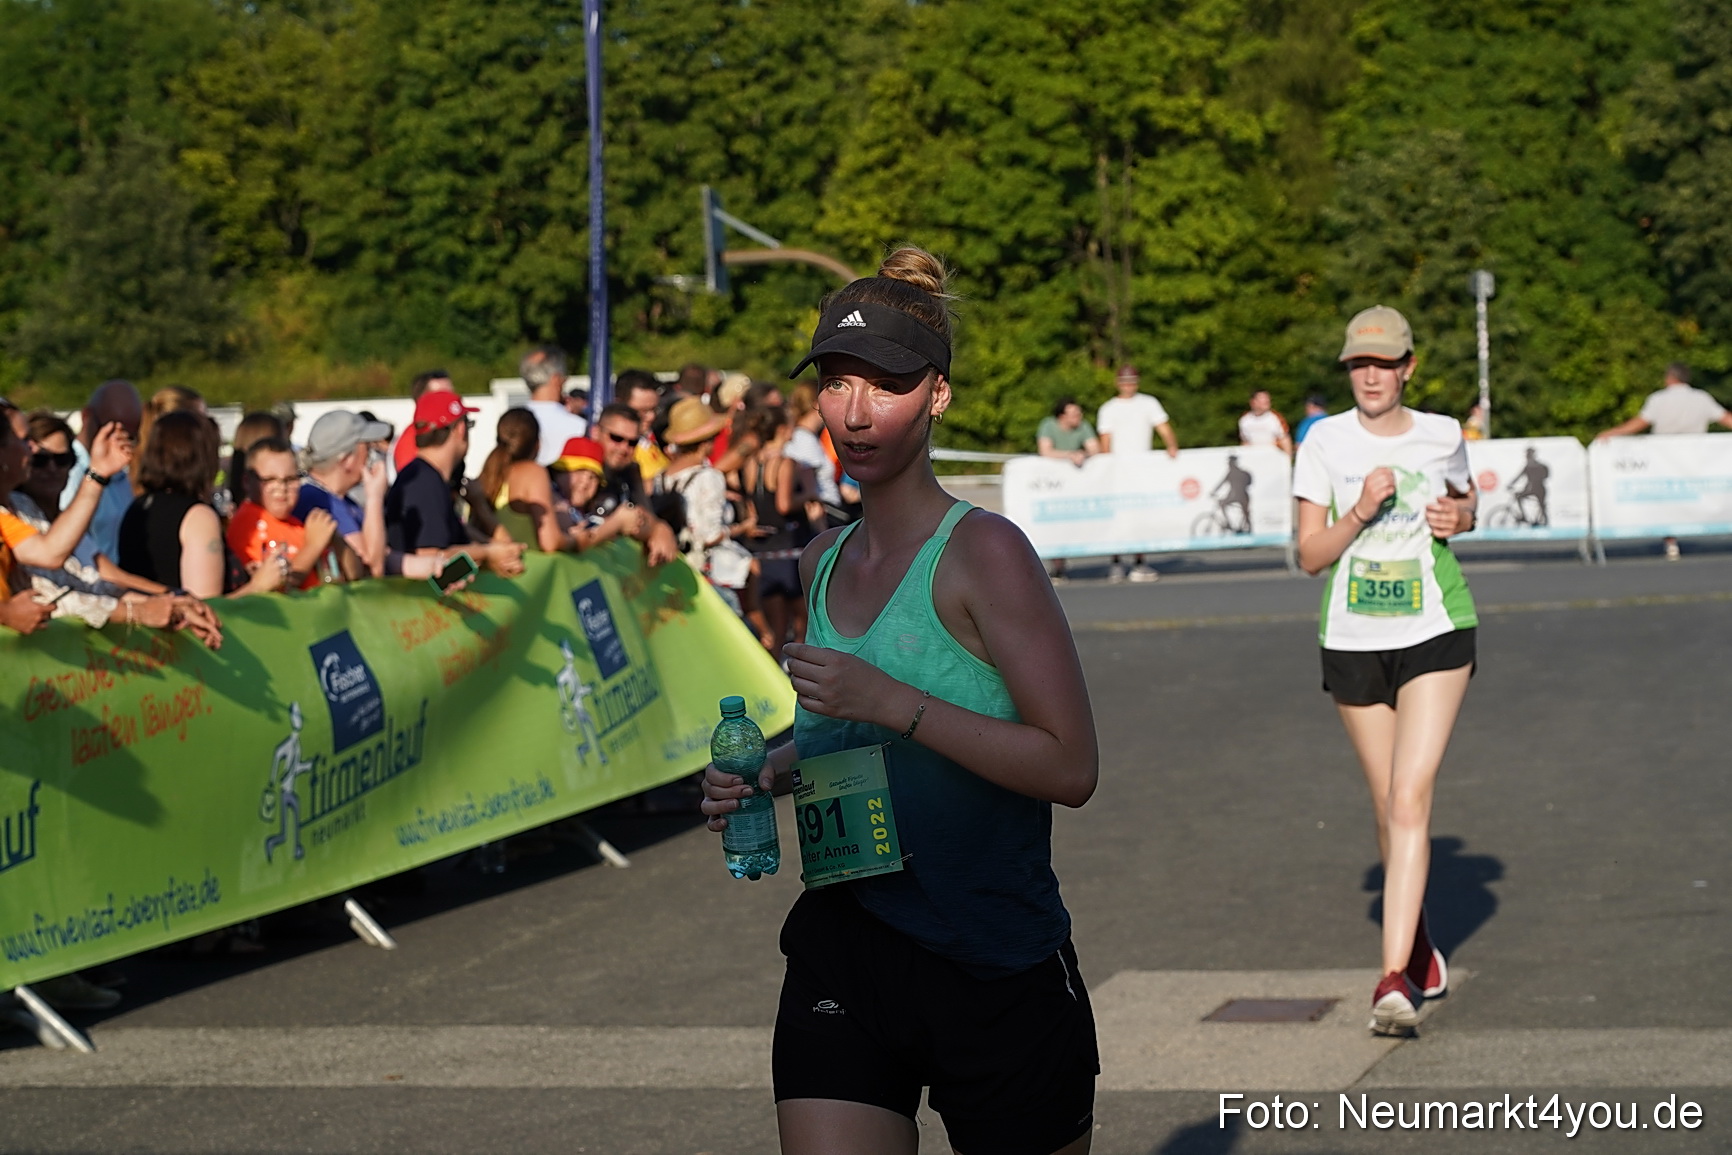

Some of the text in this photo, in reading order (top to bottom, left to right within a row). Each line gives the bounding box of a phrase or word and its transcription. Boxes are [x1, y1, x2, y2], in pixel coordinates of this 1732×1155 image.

[1365, 579, 1406, 599] 356
[309, 698, 428, 822] firmenlauf
[0, 779, 41, 868] uf
[824, 844, 860, 860] Anna
[867, 797, 891, 856] 2022
